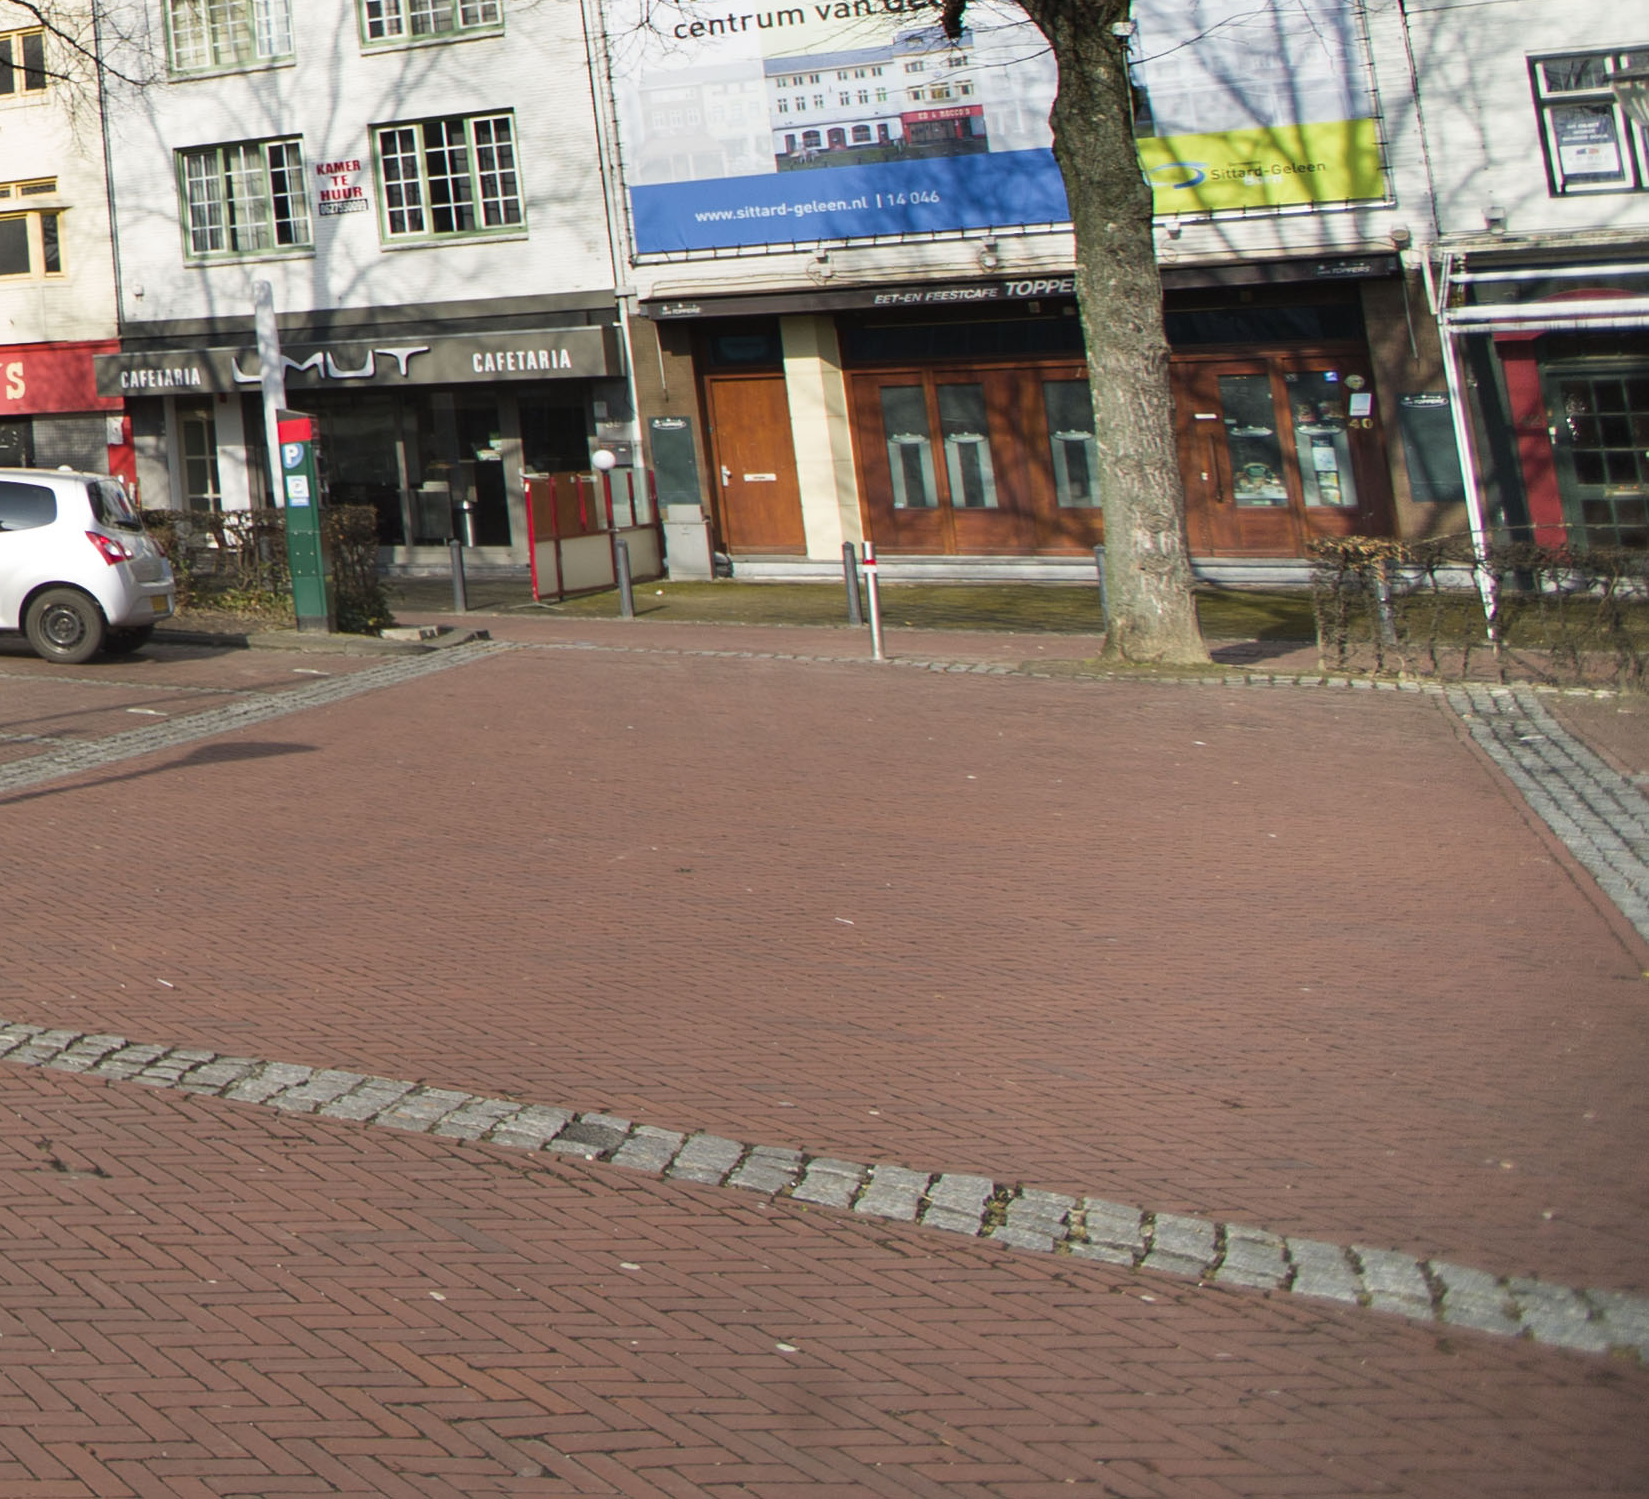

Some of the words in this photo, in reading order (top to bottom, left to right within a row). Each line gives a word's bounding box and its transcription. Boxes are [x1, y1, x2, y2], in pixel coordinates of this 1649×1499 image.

[674, 6, 805, 40] centrum
[316, 159, 362, 176] KAMER
[1210, 162, 1326, 181] Sittard-Geleen
[330, 174, 350, 187] TE
[319, 186, 363, 202] HUUR
[694, 195, 869, 223] www.sittard-geleen.nl
[886, 193, 906, 208] 14
[909, 189, 941, 205] 046
[874, 292, 923, 305] EET-EN
[925, 288, 999, 302] FEESTCAFE
[471, 349, 572, 373] CAFETARIA
[120, 366, 201, 389] CAFETARIA
[1349, 418, 1374, 429] 40
[284, 444, 299, 465] P
